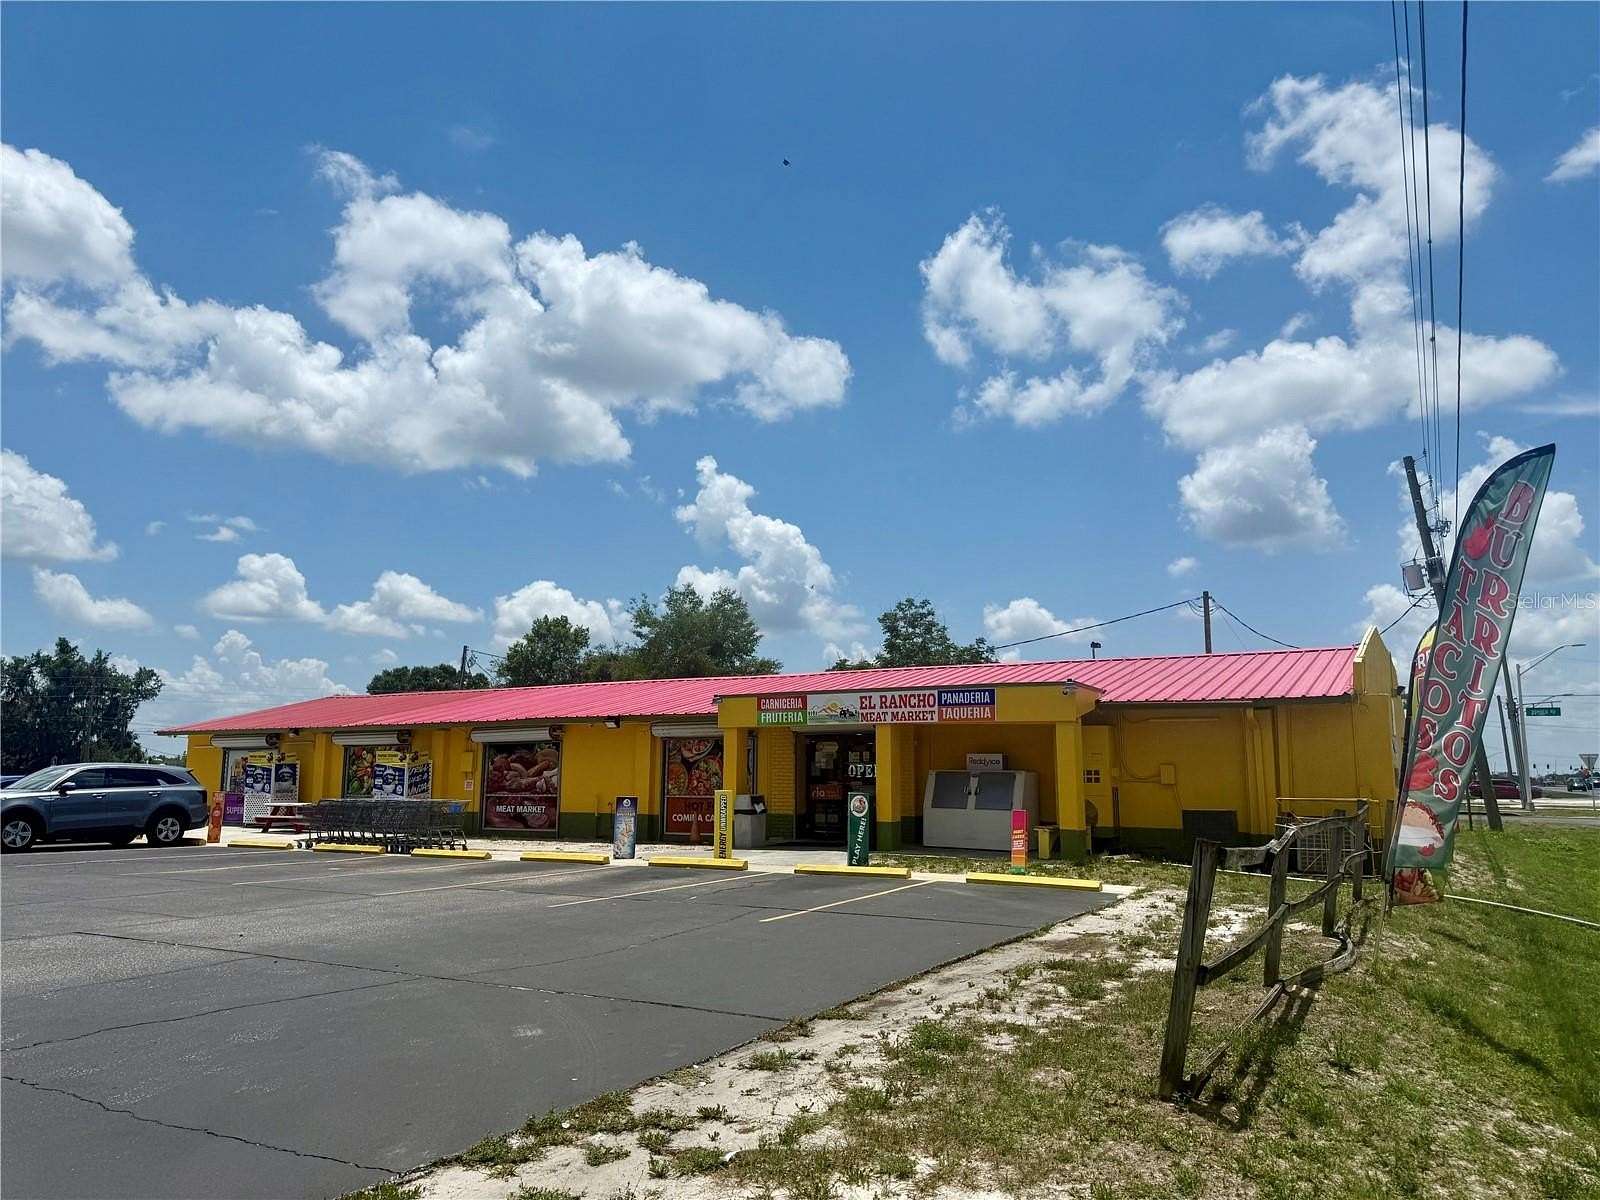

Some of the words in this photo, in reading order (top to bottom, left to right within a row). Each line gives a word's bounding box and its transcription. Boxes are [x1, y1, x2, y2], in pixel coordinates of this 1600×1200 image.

[1432, 479, 1537, 803] BURRITOS
[1415, 558, 1479, 754] TACOS
[760, 696, 803, 709] CARNICERIA
[859, 695, 877, 710] EL
[879, 693, 937, 709] RANCHO
[941, 691, 991, 704] PANADERIA
[760, 711, 804, 723] FRUTERIA
[860, 711, 890, 723] MEAT
[890, 709, 936, 722] MARKET
[942, 706, 992, 719] TAQUERIA
[496, 804, 515, 813] MEAT
[516, 804, 546, 813] MARKET
[856, 817, 867, 843] HERE!
[852, 843, 862, 865] PLAY
